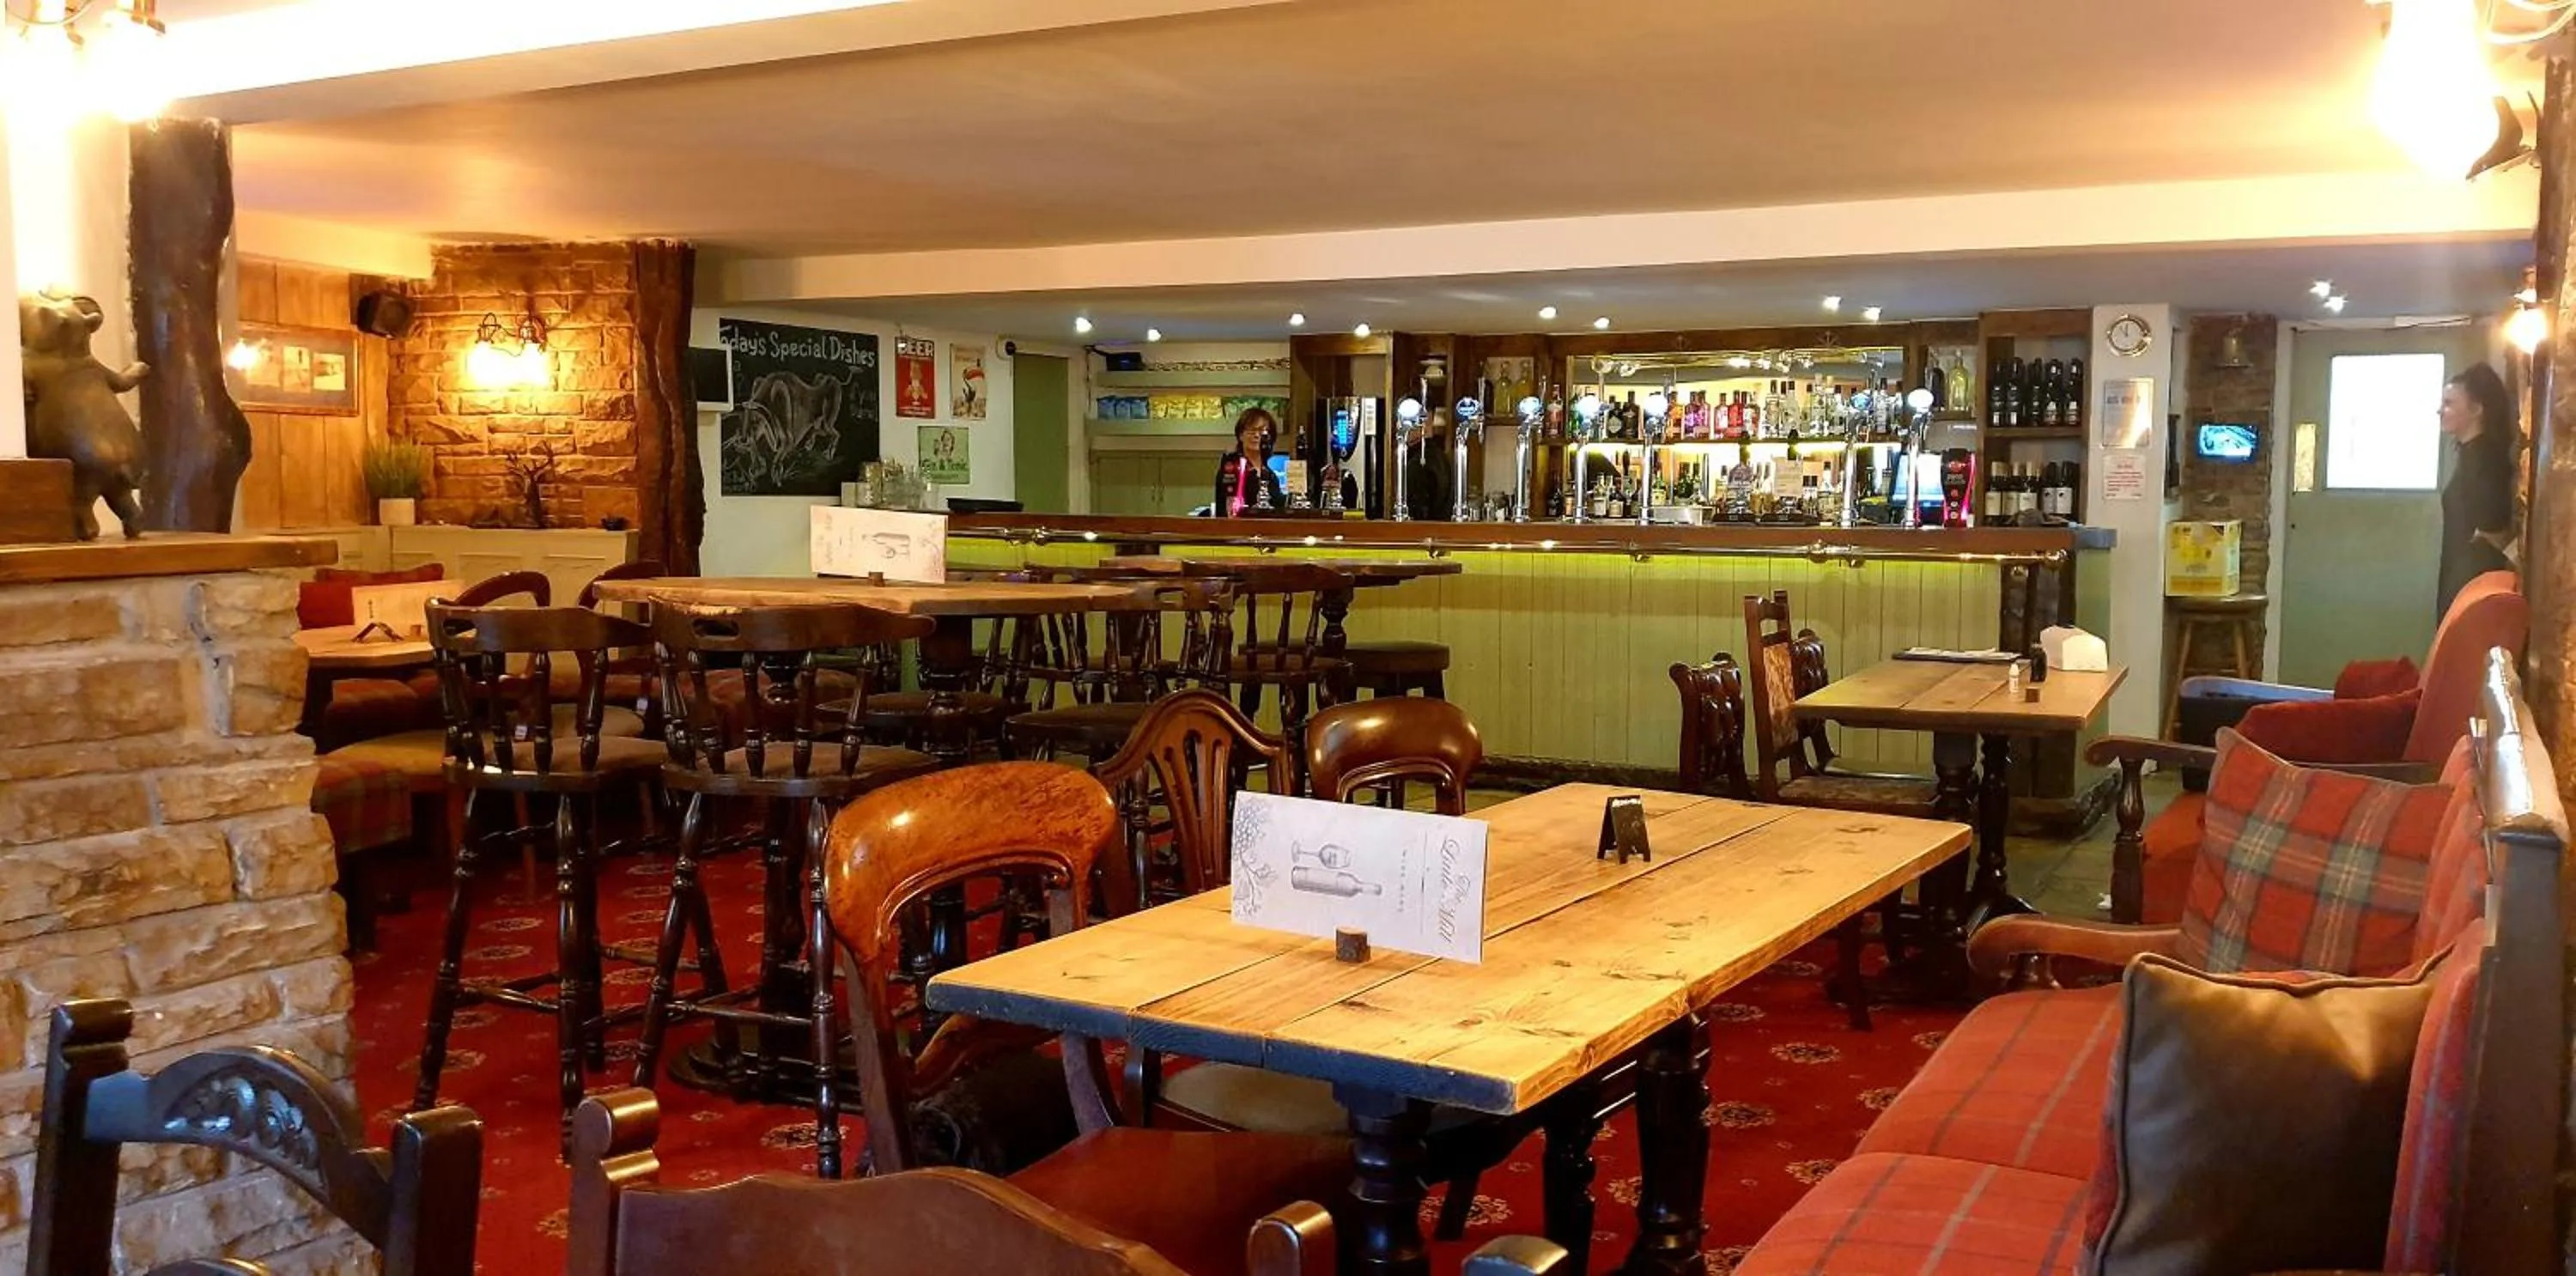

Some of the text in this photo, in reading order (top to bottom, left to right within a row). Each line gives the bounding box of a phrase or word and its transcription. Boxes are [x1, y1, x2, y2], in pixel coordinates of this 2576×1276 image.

[769, 331, 827, 361] Special
[829, 336, 875, 367] Dishes
[897, 339, 933, 356] BEER
